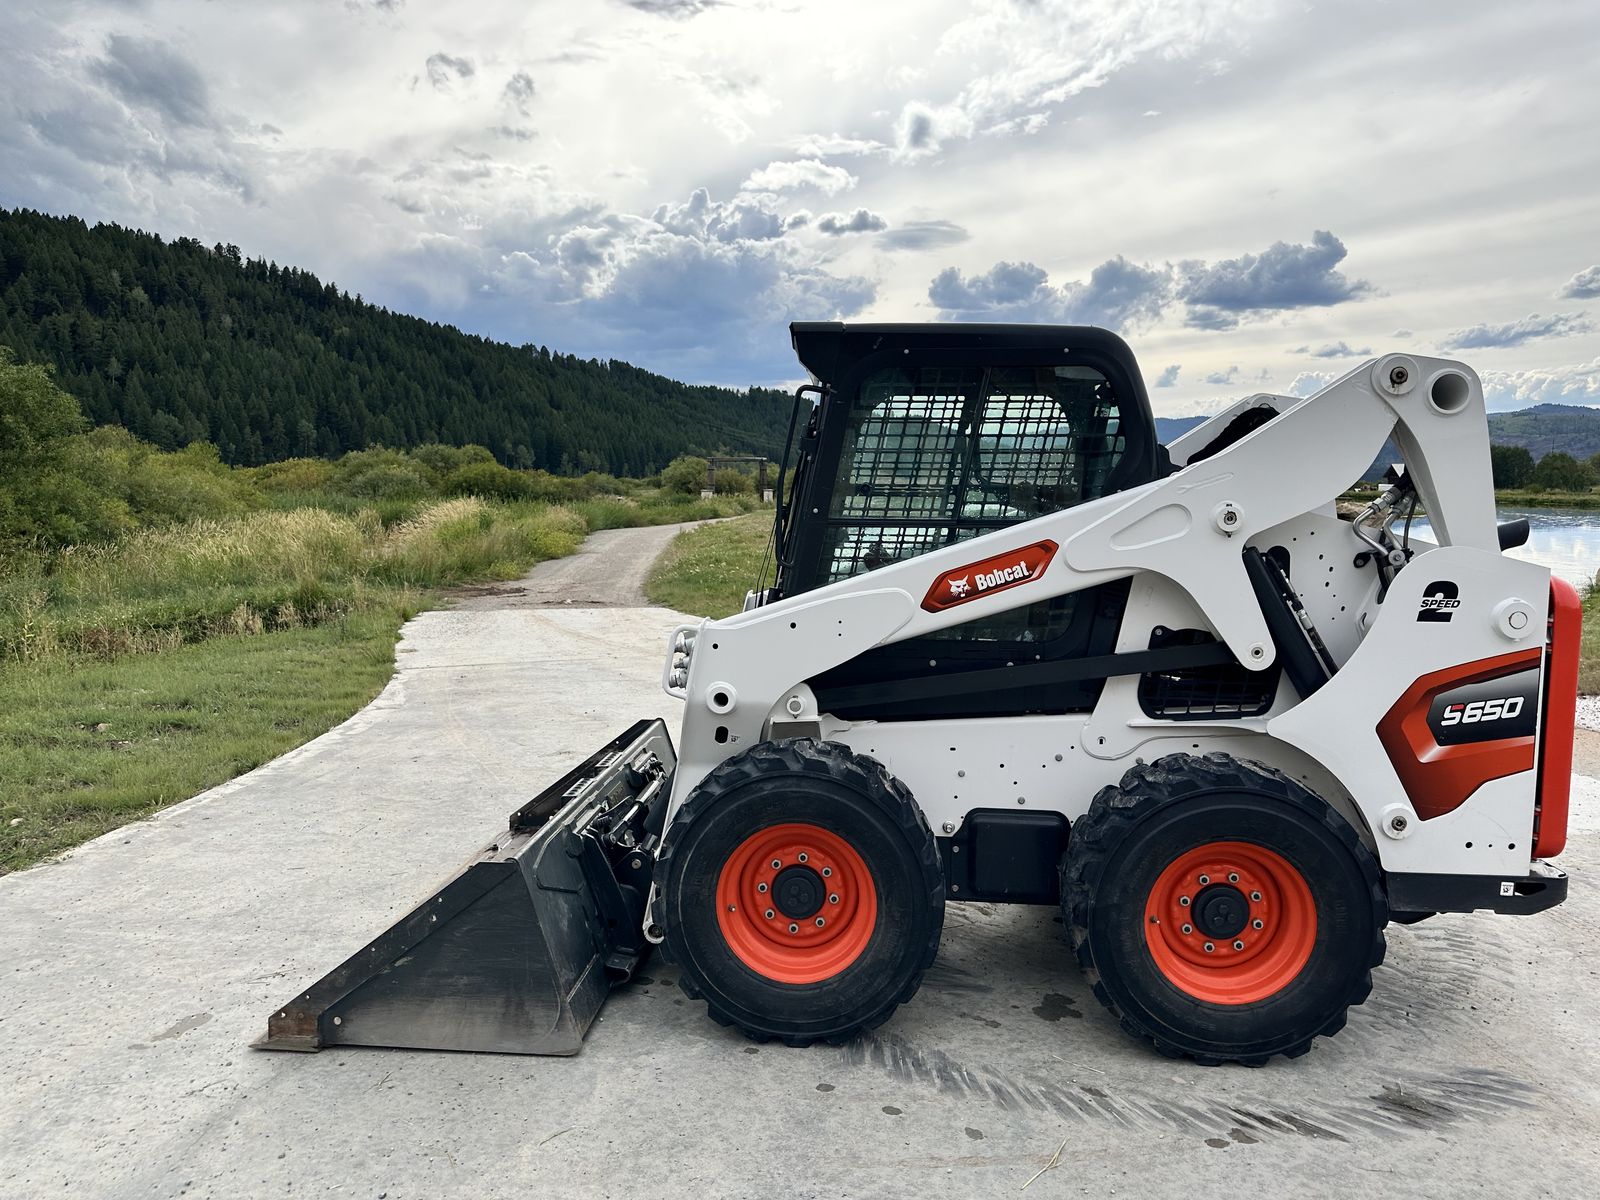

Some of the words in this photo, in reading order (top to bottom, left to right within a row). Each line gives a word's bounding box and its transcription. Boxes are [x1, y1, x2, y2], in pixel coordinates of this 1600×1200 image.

[975, 561, 1029, 591] Bobcat
[1416, 580, 1459, 622] 2
[1420, 599, 1461, 608] SPEED
[1440, 696, 1524, 726] S650
